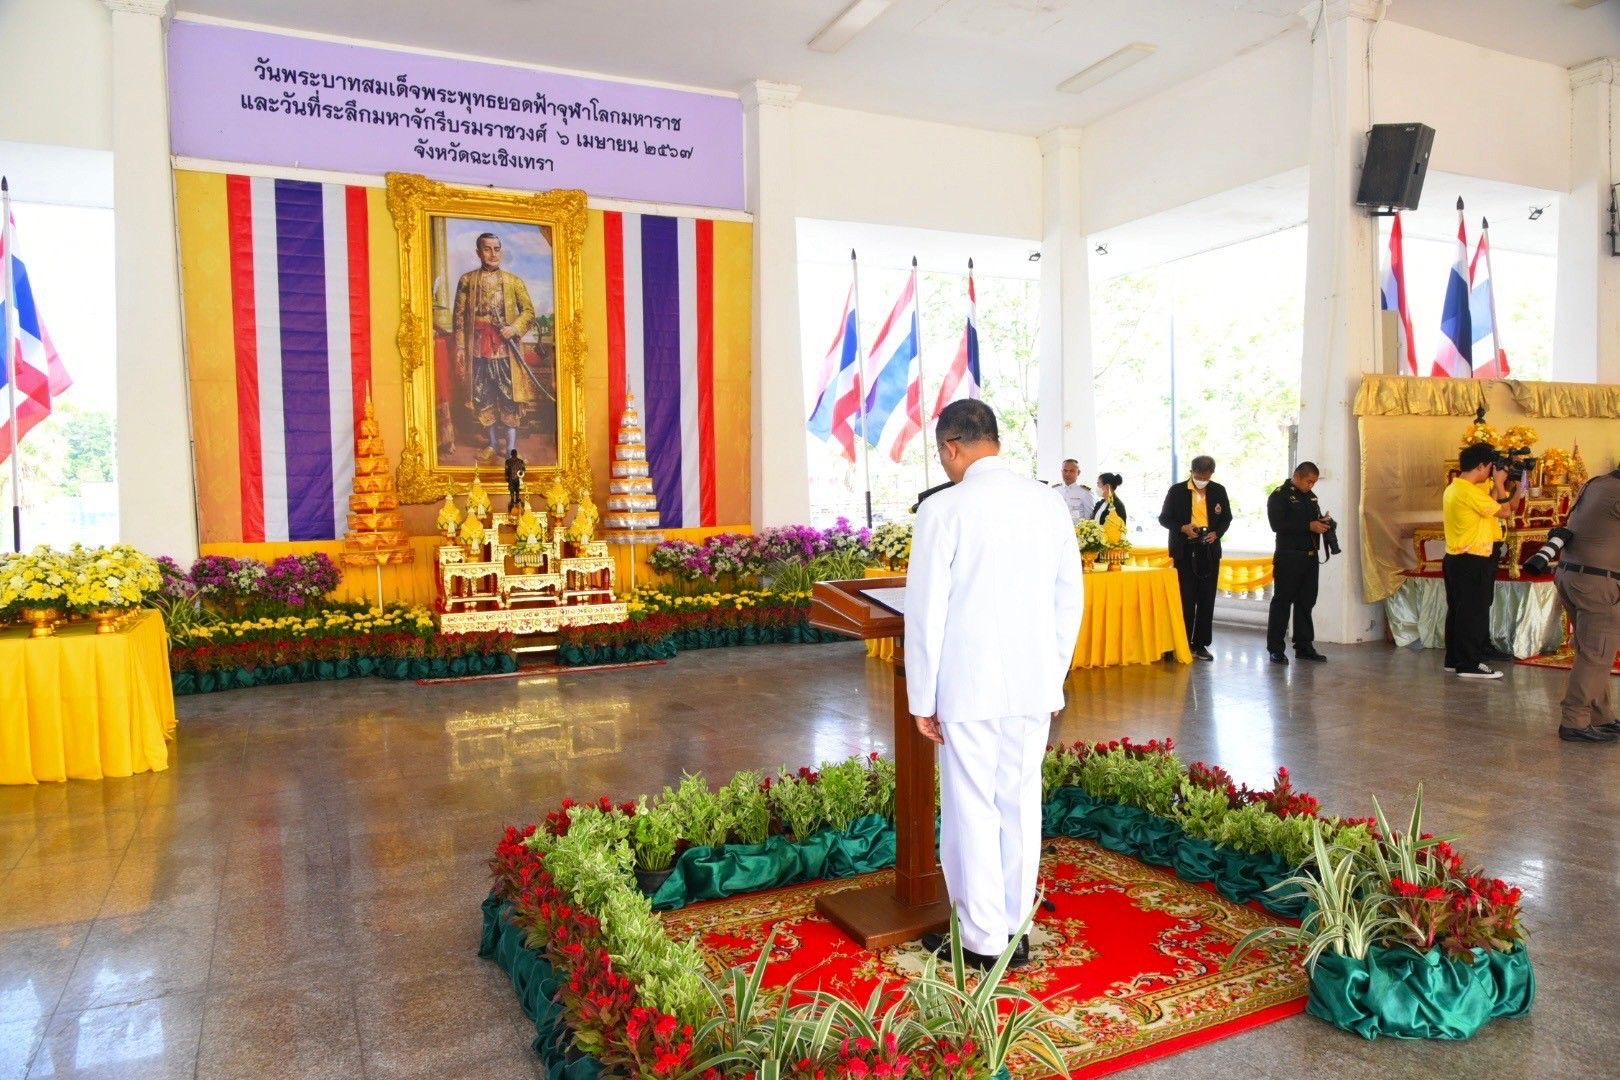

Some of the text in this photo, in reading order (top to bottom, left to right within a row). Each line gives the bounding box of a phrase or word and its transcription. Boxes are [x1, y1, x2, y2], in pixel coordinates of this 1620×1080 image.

[240, 90, 694, 160] และวันที่ระลึกมหาจักรีบรมราชวงศ์ ๖ เมษายน ๒๕๖๗
[254, 57, 682, 132] วันพระบาทสมเด็จพระพุทธยอดฟ้าจุฬาโลกมหาราช
[414, 138, 554, 172] จังหวัดฉะเชิงเทรา
